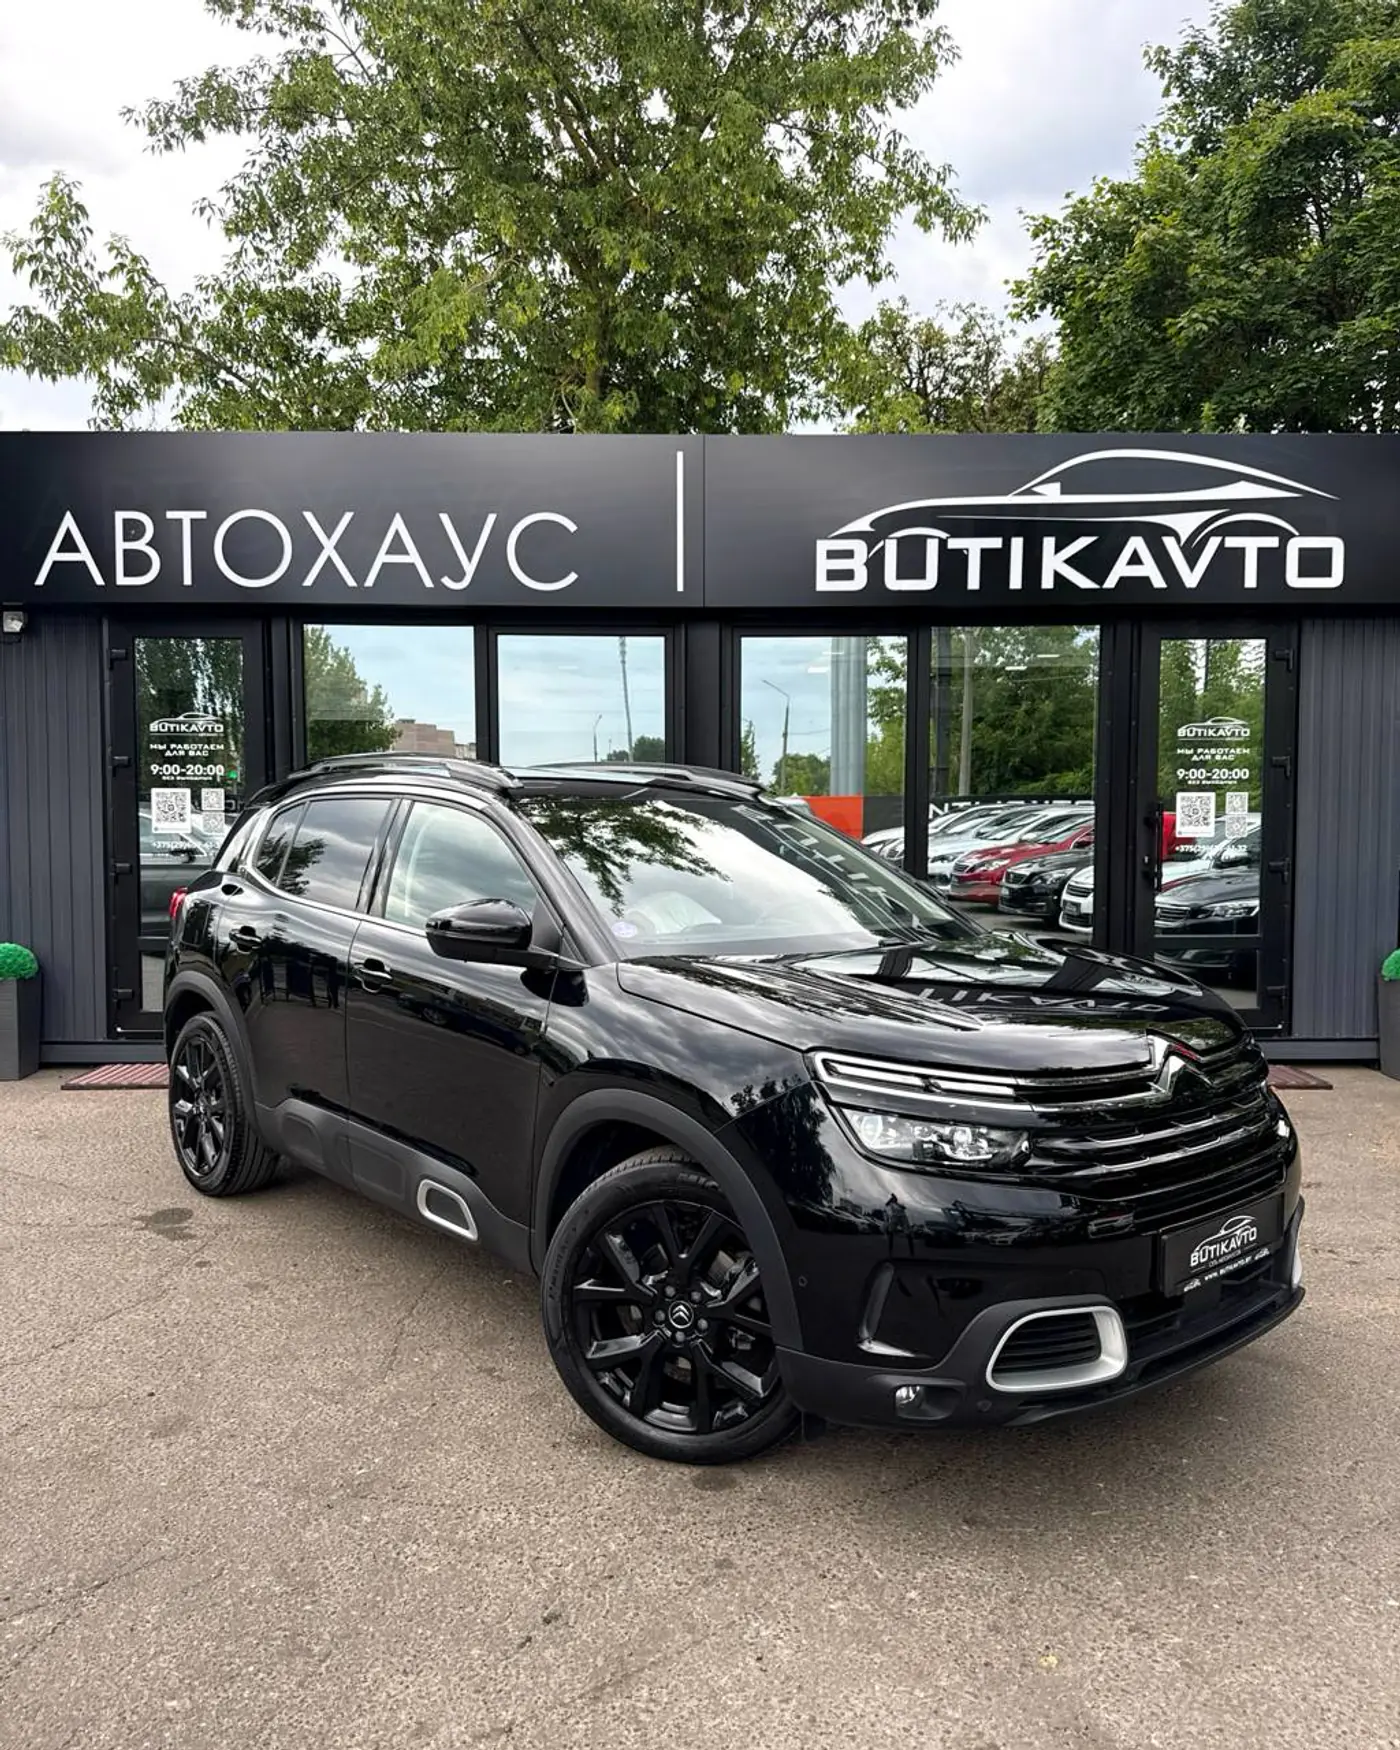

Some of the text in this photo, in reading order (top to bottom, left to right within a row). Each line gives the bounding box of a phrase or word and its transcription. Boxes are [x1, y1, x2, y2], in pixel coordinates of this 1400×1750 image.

[35, 509, 579, 592] АВТОХАУС
[815, 536, 1346, 592] BUTIKAVTO
[149, 723, 224, 733] BUTIKAVTO
[1177, 728, 1250, 737] BUTIKAVTO
[150, 743, 224, 751] МЫ РАБОТАЕМ
[150, 764, 225, 776] 9:00-20:00
[1176, 768, 1250, 780] 9:00-20:00
[1190, 1226, 1257, 1267] BUTIKAVTO
